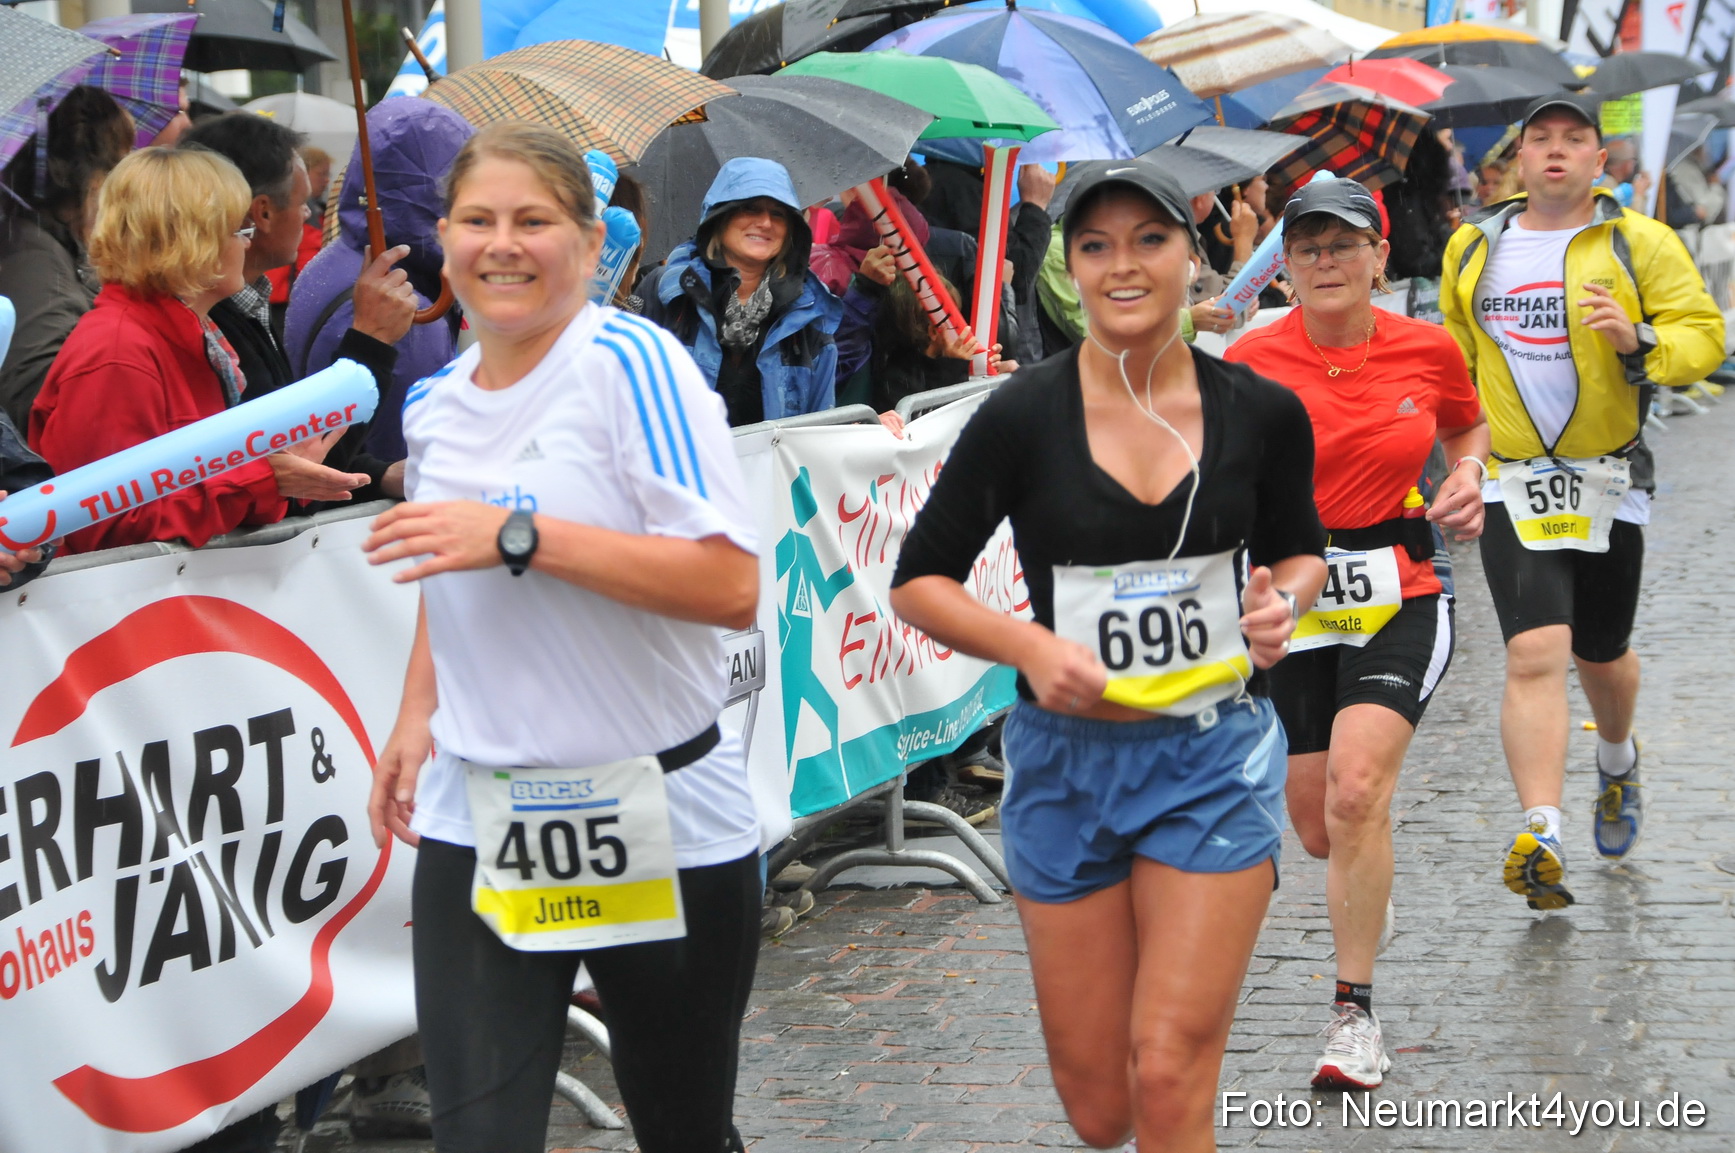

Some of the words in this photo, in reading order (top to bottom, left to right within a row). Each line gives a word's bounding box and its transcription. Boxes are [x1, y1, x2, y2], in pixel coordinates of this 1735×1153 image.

[1233, 283, 1257, 303] TUI
[1249, 253, 1285, 288] ReiseC
[1554, 350, 1573, 361] Aut
[80, 479, 144, 522] TUI
[150, 402, 358, 497] ReiseCenter
[1525, 474, 1583, 515] 596
[1314, 560, 1373, 607] 45
[1098, 598, 1209, 670] 696
[1319, 615, 1362, 632] renate
[310, 727, 337, 784] &
[510, 778, 595, 800] BOCK
[496, 815, 628, 880] 405
[535, 896, 602, 924] Jutta
